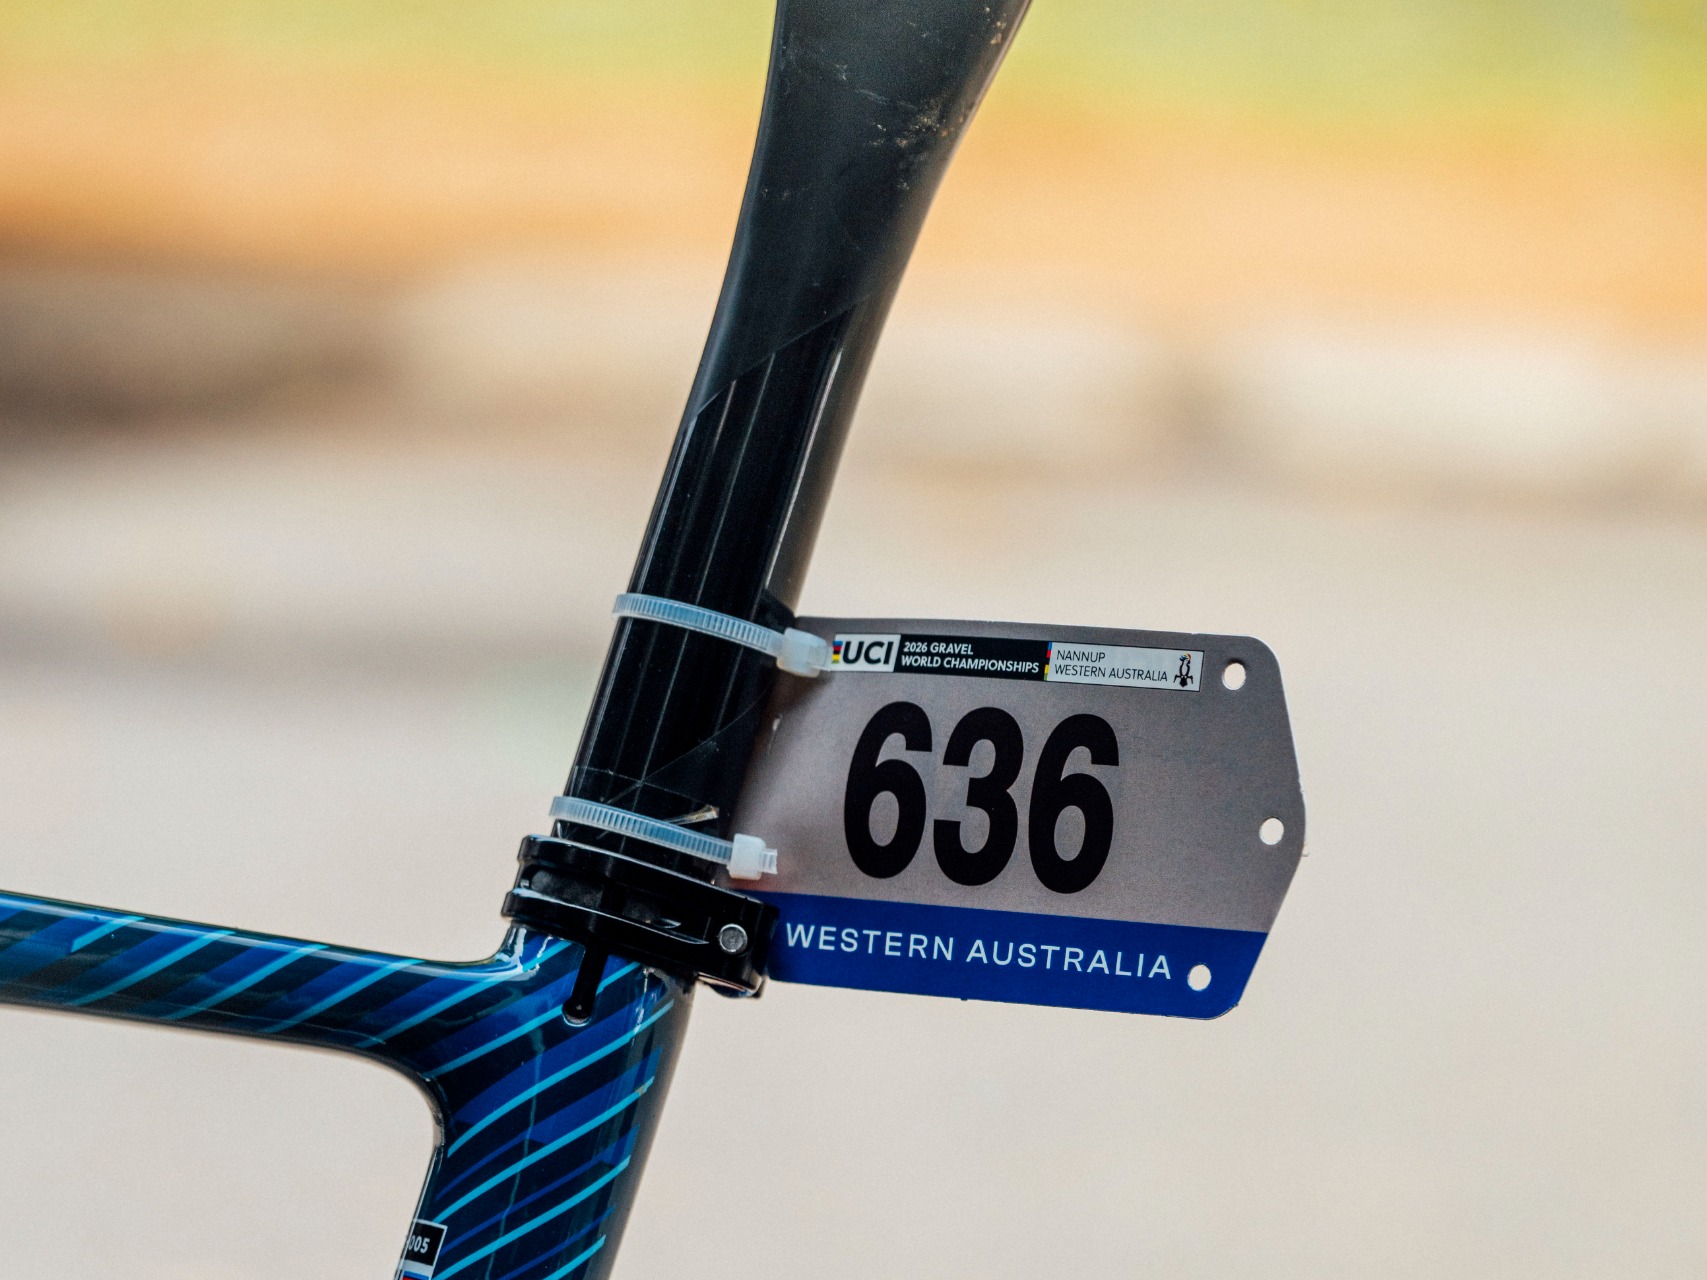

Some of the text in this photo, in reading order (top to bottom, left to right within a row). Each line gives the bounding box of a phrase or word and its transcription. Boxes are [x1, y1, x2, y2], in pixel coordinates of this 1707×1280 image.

[842, 641, 894, 665] UCI
[903, 642, 974, 655] 2026 GRAVEL
[1056, 650, 1106, 663] NANNUP
[901, 655, 1040, 673] WORLD CHAMPIONSHIPS
[1054, 664, 1168, 682] WESTERN AUSTRALIA
[844, 701, 1119, 894] 636
[786, 923, 1172, 980] WESTERN AUSTRALIA
